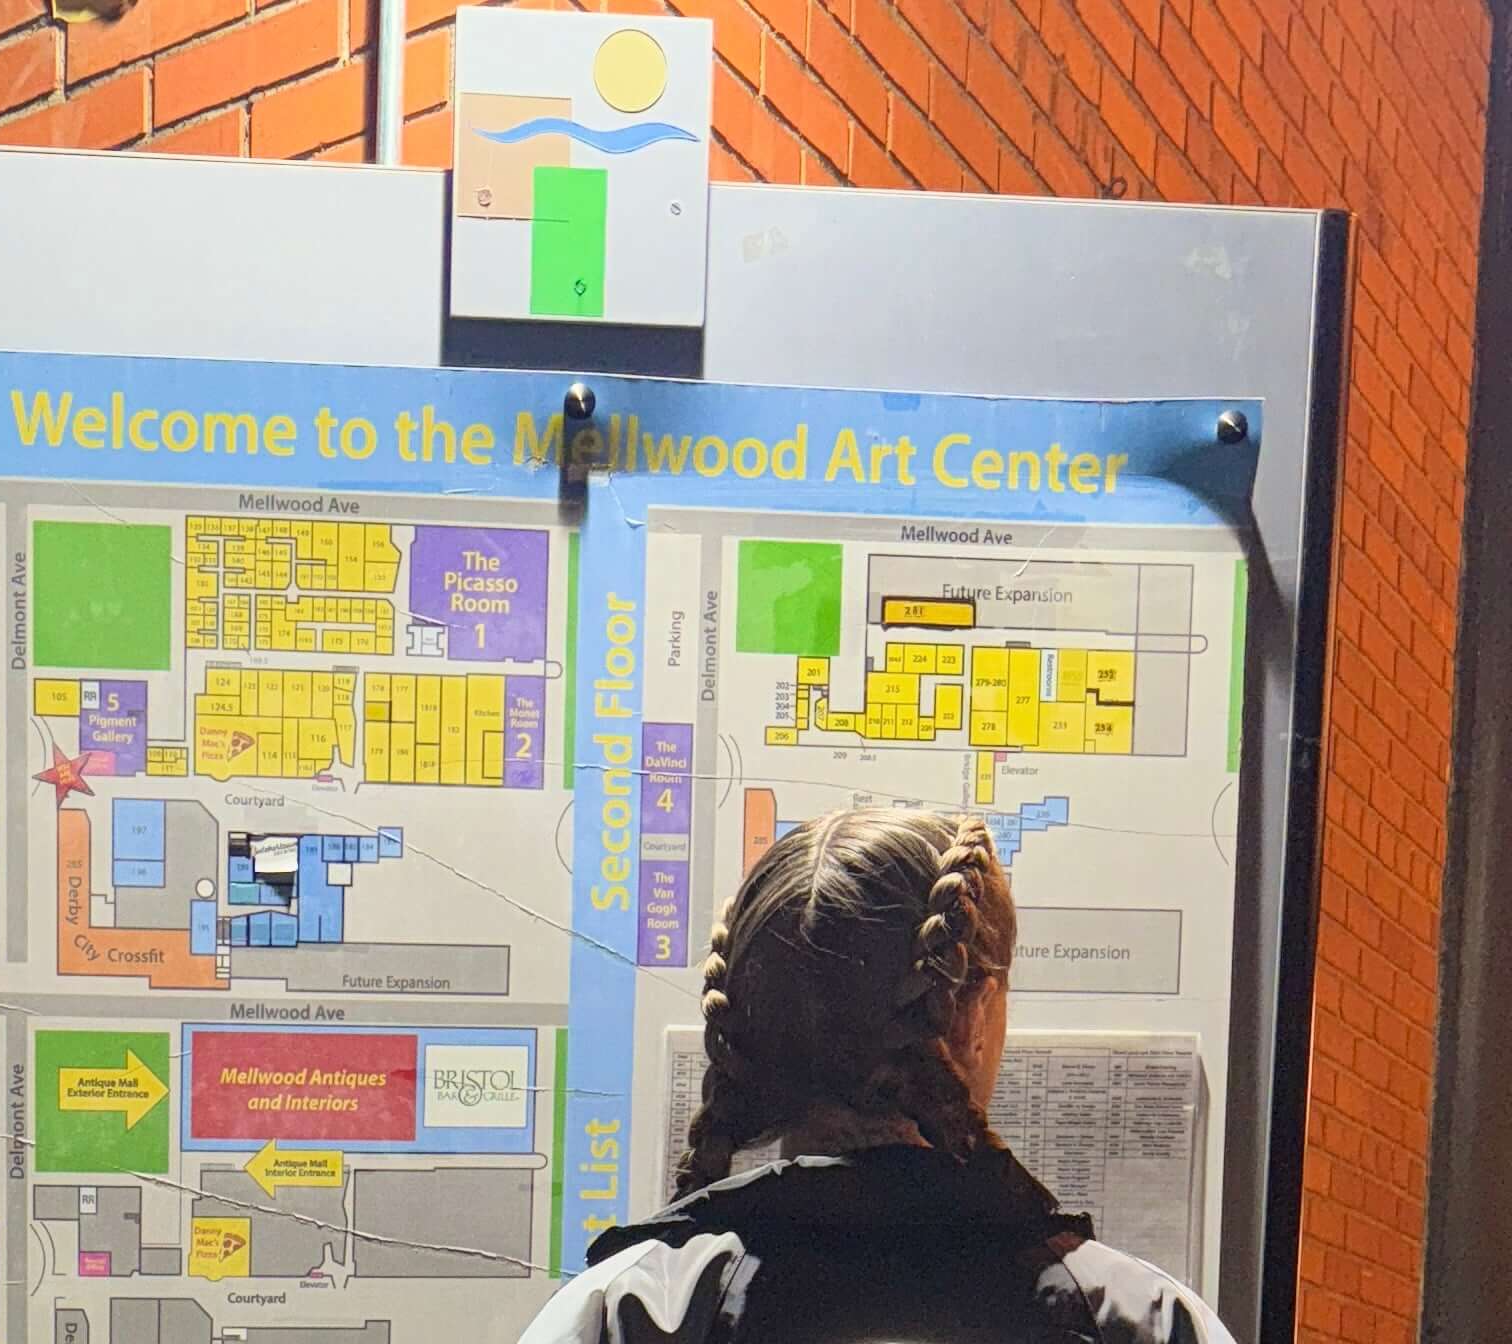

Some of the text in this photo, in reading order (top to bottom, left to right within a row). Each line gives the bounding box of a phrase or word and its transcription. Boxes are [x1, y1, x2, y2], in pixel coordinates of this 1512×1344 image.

[10, 388, 1129, 494] Welcome to the Mellwood Art Center
[238, 494, 360, 514] Mellwood Ave
[900, 525, 1013, 544] Mellwood Ave
[462, 550, 500, 571] The
[443, 571, 518, 593] Picasso
[942, 583, 1073, 604] Future Expansion
[450, 592, 510, 614] Room
[11, 552, 28, 671] Delmont Ave
[474, 623, 486, 649] 1
[668, 610, 685, 667] Parking
[701, 591, 718, 702] Delmont Ave
[912, 655, 928, 663] 224
[215, 678, 231, 687] 124
[107, 693, 119, 711] 5
[516, 698, 534, 708] The
[1016, 696, 1030, 704] 277
[89, 714, 137, 729] Pigment
[511, 719, 538, 729] Room
[92, 730, 134, 744] Gallery
[311, 734, 327, 743] 116
[516, 732, 532, 758] 2
[592, 591, 637, 911] Second Floor
[656, 741, 677, 753] The
[646, 756, 687, 769] DaVinci
[1001, 766, 1038, 776] Elevator
[225, 794, 285, 808] Courtyard
[656, 789, 674, 812] 4
[654, 872, 675, 884] The
[654, 888, 675, 899] Van
[647, 902, 677, 915] Gogh
[66, 876, 165, 964] Derby City Crossfit
[647, 918, 679, 929] Room
[655, 935, 672, 958] 3
[1054, 943, 1130, 963] Expansion
[342, 974, 451, 991] Future Expansion
[230, 1004, 345, 1020] Mellwood Ave
[78, 1078, 138, 1091] Antique Mall
[220, 1067, 387, 1089] Mellwood Antiques
[433, 1070, 515, 1090] BRISTOL
[67, 1088, 149, 1099] Exterior Entrance
[248, 1095, 359, 1112] and Interiors
[10, 1064, 25, 1179] Delmont Ave
[273, 1158, 328, 1169] Antique Mall
[580, 1118, 620, 1200] List
[265, 1168, 336, 1178] Interior Entrance
[194, 1226, 222, 1236] Danny
[196, 1238, 219, 1247] Mac's
[300, 1281, 329, 1289] Elevator
[227, 1292, 286, 1306] Courtyard
